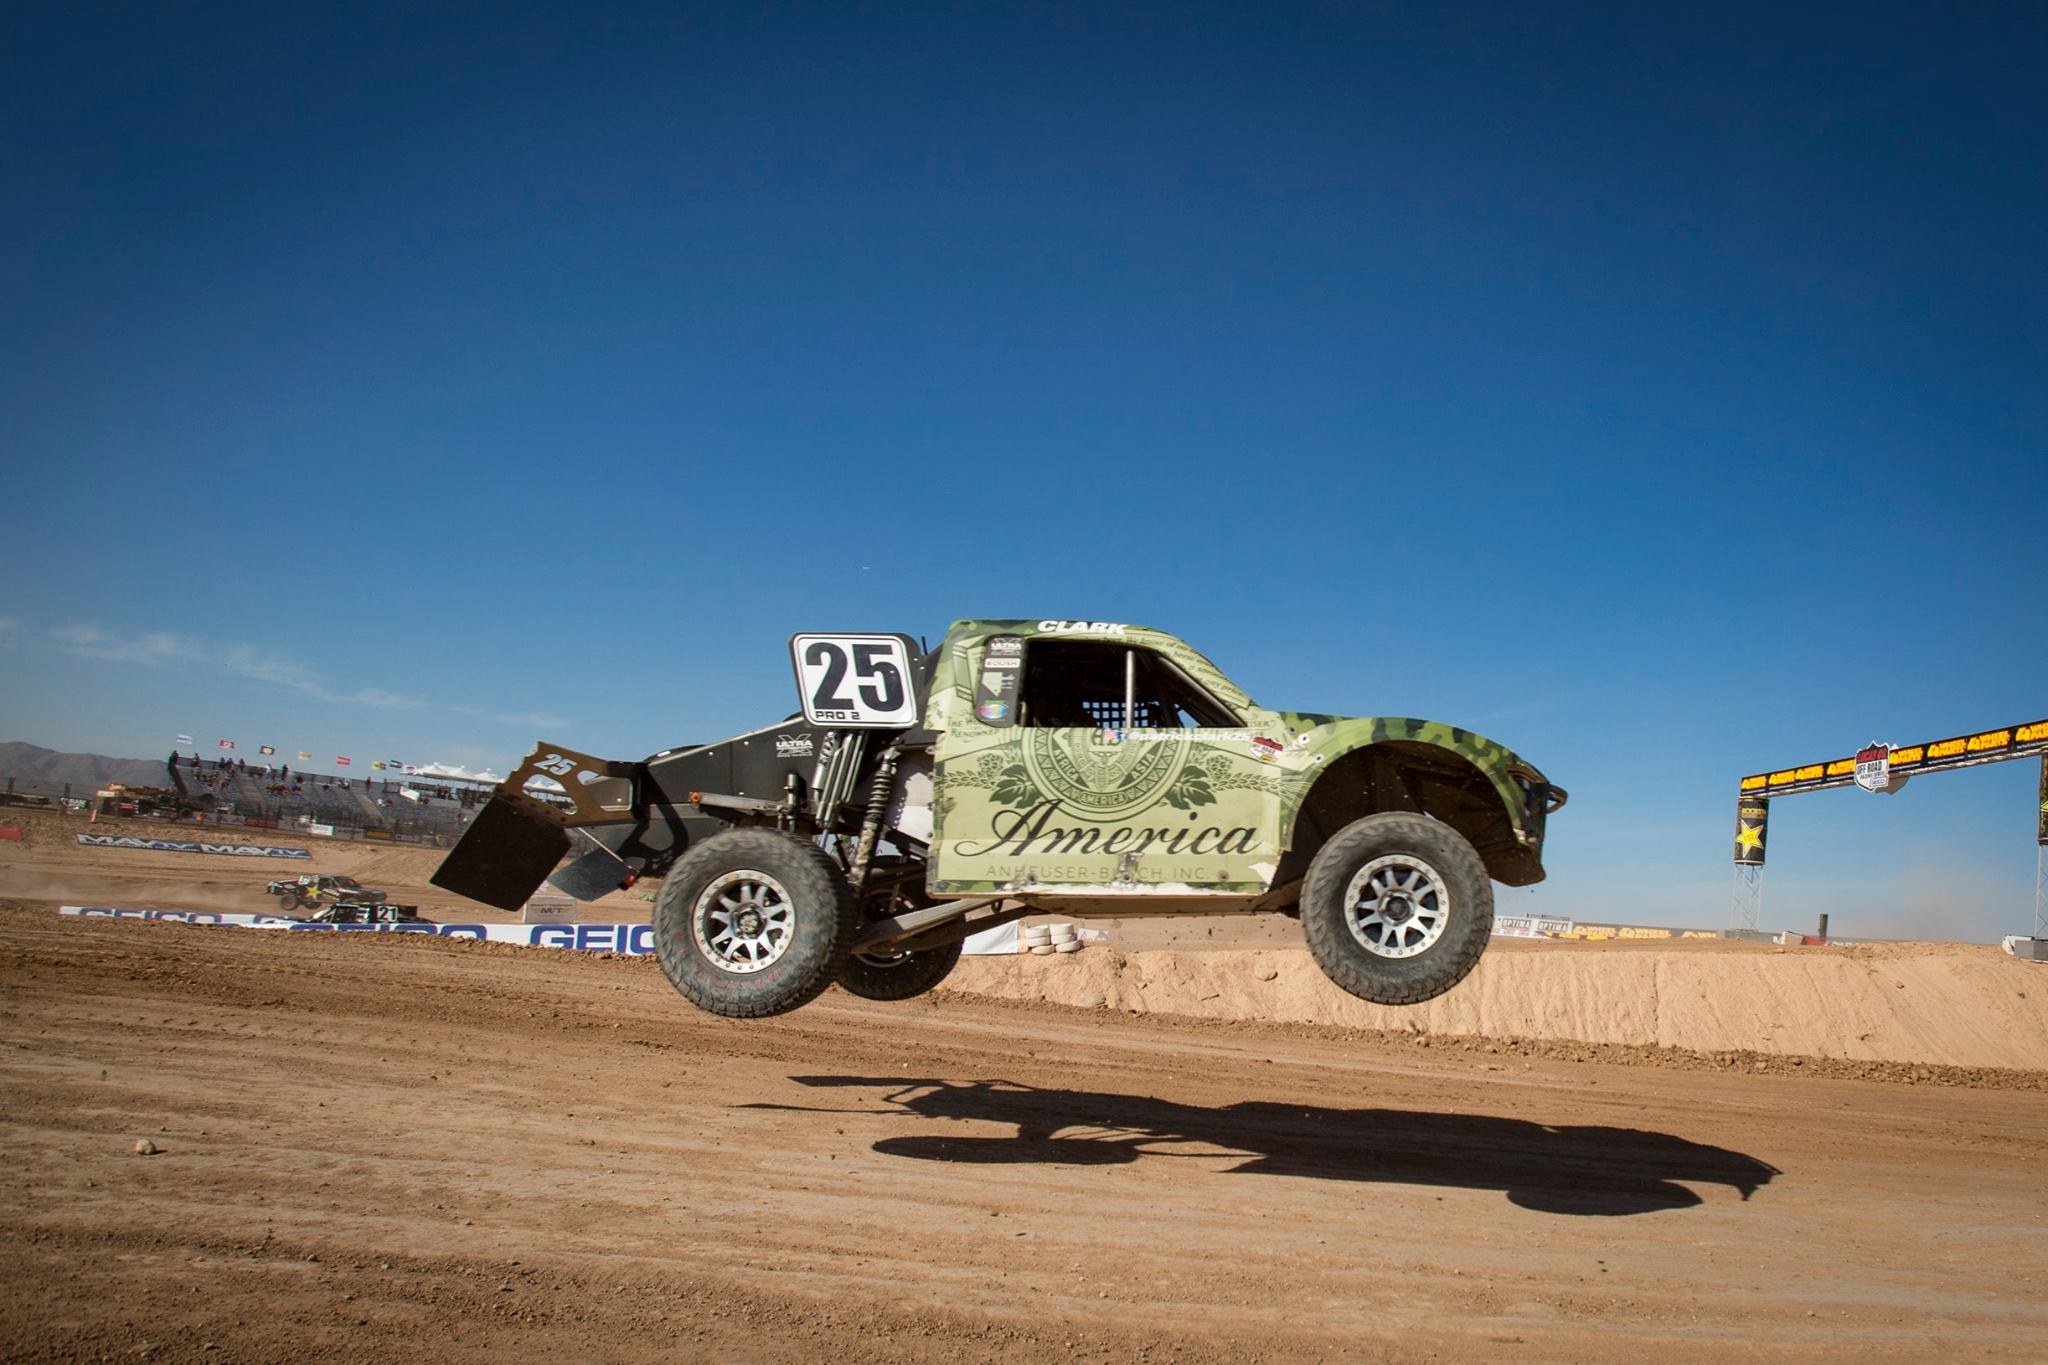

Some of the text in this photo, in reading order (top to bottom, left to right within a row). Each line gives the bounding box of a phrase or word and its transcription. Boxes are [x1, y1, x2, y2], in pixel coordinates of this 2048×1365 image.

[1037, 620, 1128, 635] CLARK
[805, 642, 905, 713] 25
[815, 711, 861, 720] PRO 2
[775, 740, 814, 748] ULTRA
[533, 753, 578, 776] 25
[1131, 752, 1156, 780] ASIA
[1867, 761, 1883, 773] ROAD
[1082, 793, 1126, 806] AMERICA
[953, 798, 1262, 858] America
[1172, 867, 1211, 880] INC.
[377, 906, 399, 922] 21
[1538, 921, 1569, 931] OPTIMA
